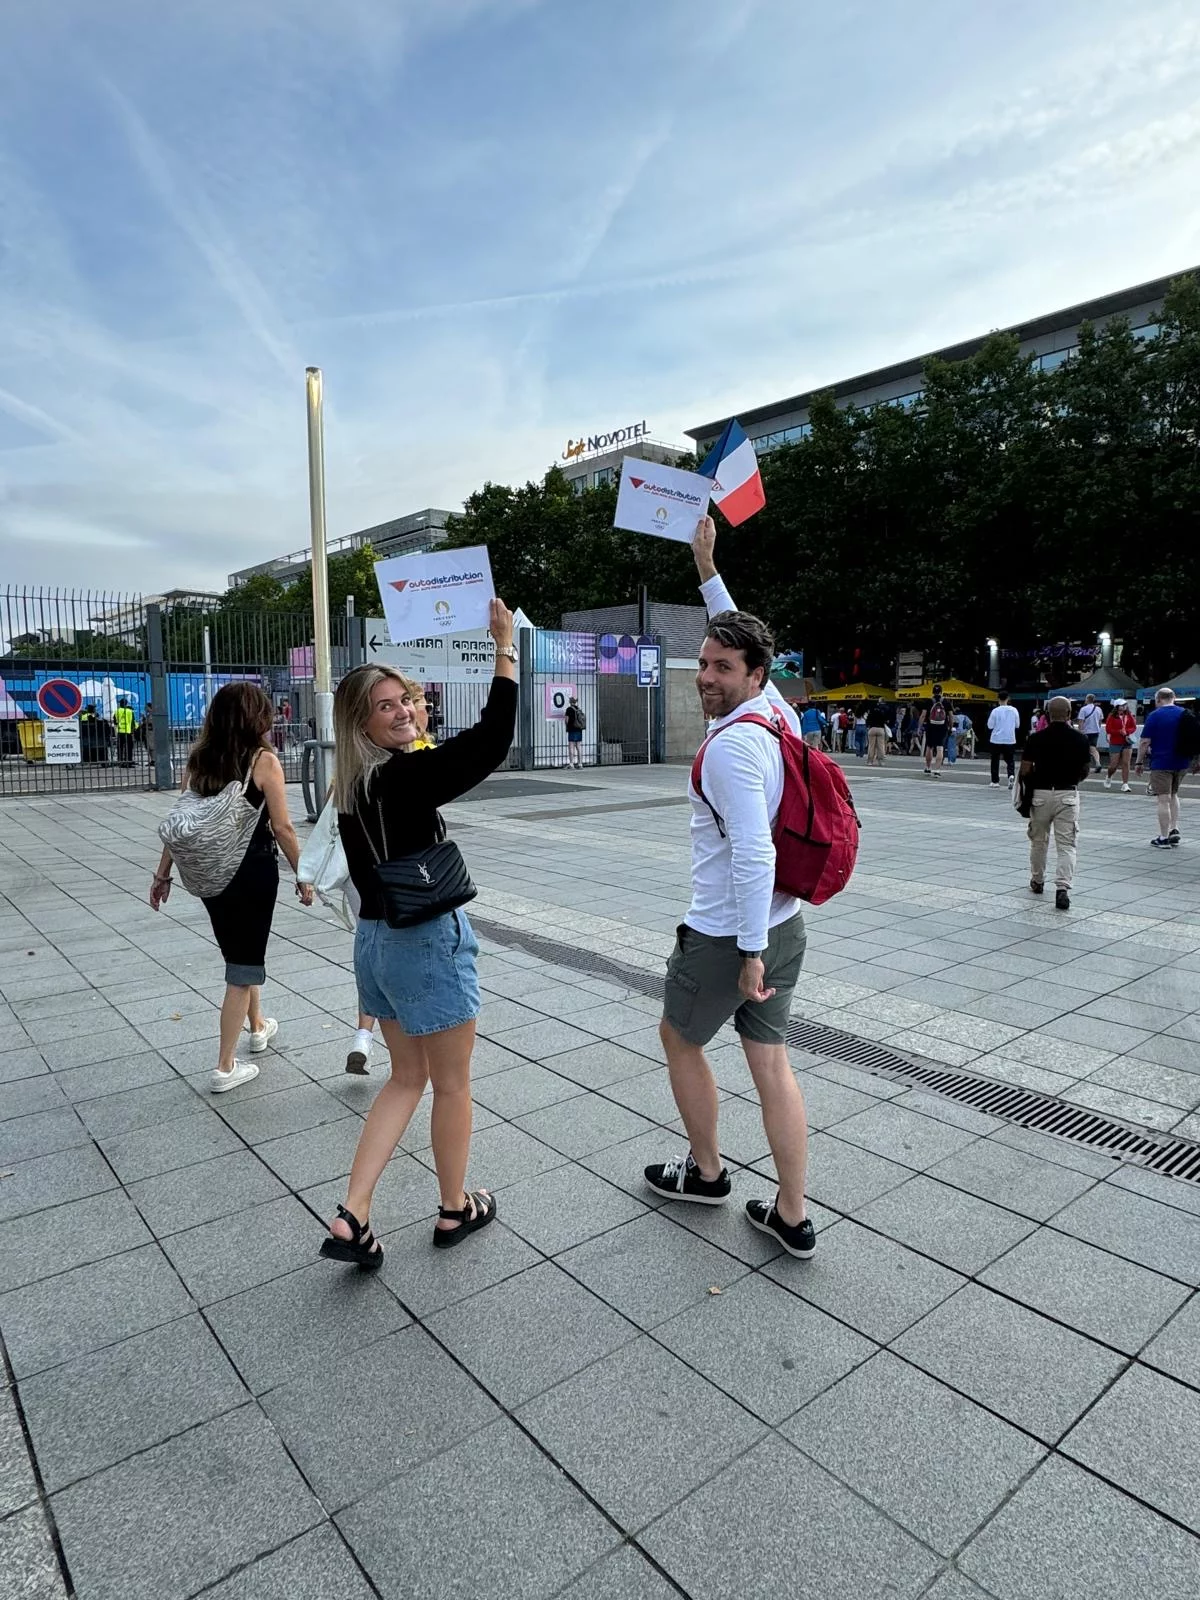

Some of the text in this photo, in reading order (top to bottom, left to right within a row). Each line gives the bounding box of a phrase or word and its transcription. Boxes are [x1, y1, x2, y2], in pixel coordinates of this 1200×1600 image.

[588, 420, 651, 451] NOVOTEL
[644, 484, 701, 503] autodistribution
[409, 572, 483, 588] autodistribution
[549, 639, 583, 652] PARIS
[550, 653, 583, 665] 2024
